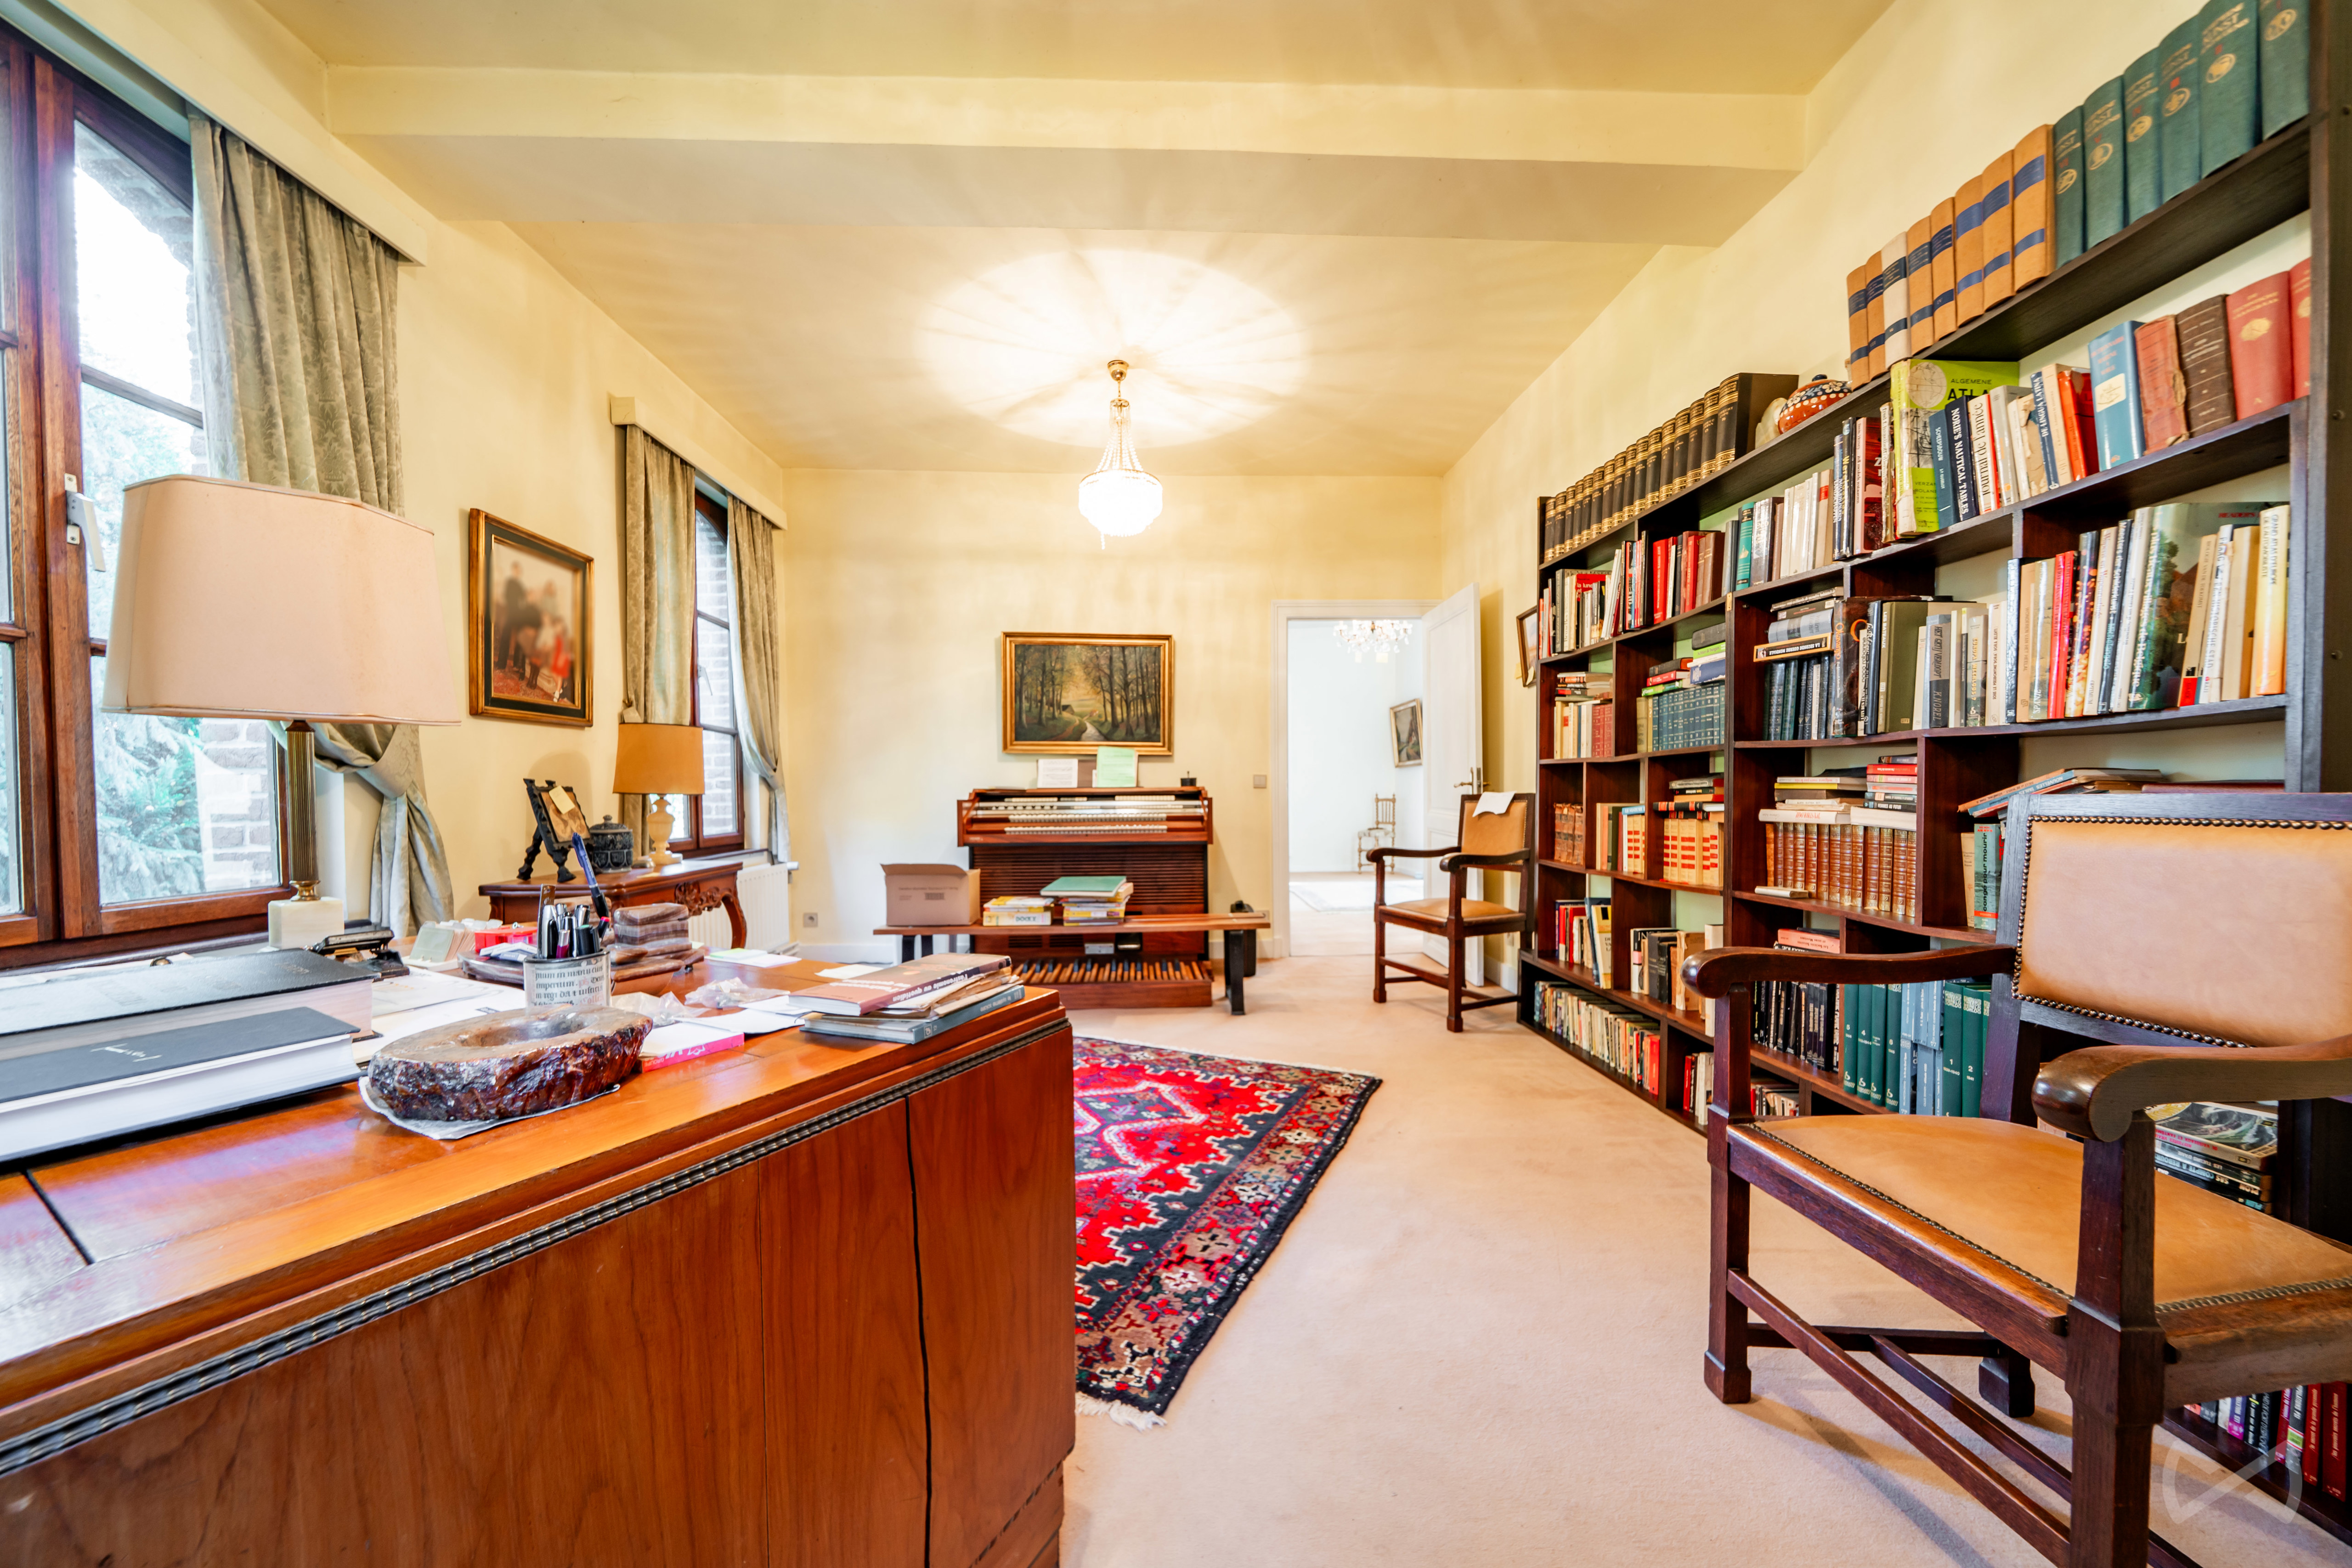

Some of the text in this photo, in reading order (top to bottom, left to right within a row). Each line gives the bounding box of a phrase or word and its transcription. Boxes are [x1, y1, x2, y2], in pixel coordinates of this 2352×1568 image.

[2032, 375, 2049, 437] DE LINGUA LATINA
[1973, 402, 1986, 441] l'année
[1977, 441, 1988, 457] de
[1951, 407, 1970, 515] NORIE'S NAUTICAL TABLES
[2101, 522, 2127, 669] Meesters der Schilderkunst Michelangelo
[1835, 623, 1844, 660] Okavango
[2136, 629, 2147, 642] de
[1769, 648, 1786, 656] MONDIALE
[1799, 643, 1814, 651] SECONDE
[2130, 643, 2145, 687] Belgique
[1933, 690, 1942, 722] KNOREL
[2033, 689, 2042, 713] SPANJE
[2035, 776, 2063, 790] NOUVELLES
[2018, 786, 2034, 796] TABLES
[892, 972, 967, 1002] l'astronomie au quotidien
[644, 1058, 665, 1067] GROUPE
[2182, 1162, 2187, 1170] A
[2188, 1164, 2215, 1179] COMPTE
[2216, 1175, 2228, 1185] SAS
[2239, 1183, 2259, 1195] PLON
